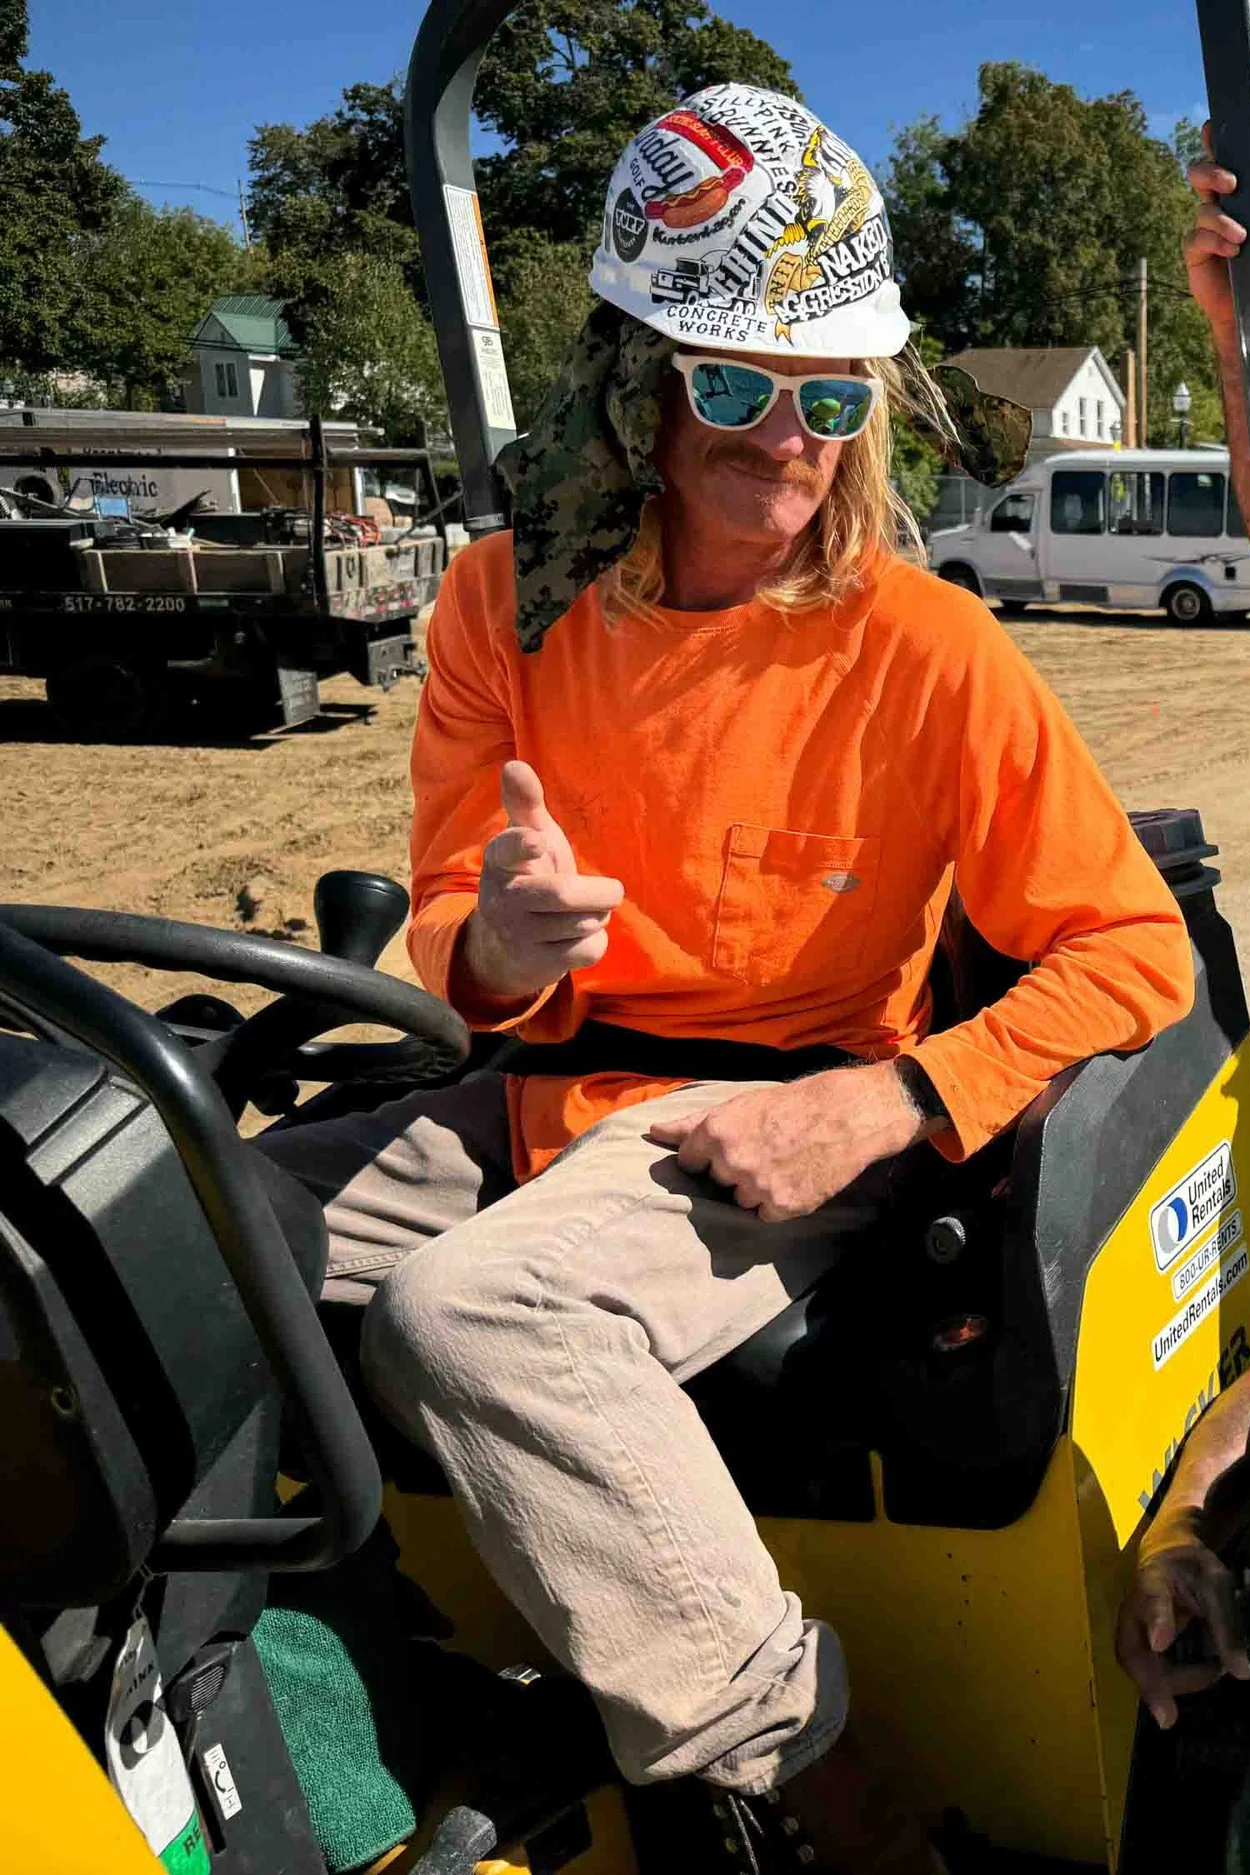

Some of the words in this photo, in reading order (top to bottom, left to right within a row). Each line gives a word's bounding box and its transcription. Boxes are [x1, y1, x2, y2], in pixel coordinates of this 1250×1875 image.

[703, 96, 771, 112] SILLY
[711, 108, 797, 194] BUNNIES
[753, 108, 795, 154] PINK
[630, 157, 645, 187] GOLF
[818, 217, 888, 285] NAKED
[774, 259, 884, 324] AGGRESSION
[667, 304, 768, 333] CONCRETE
[679, 320, 749, 342] WORKS
[1188, 1156, 1224, 1206] United
[1192, 1178, 1231, 1230] Rentals
[1154, 1252, 1248, 1364] UnitedRentals.com
